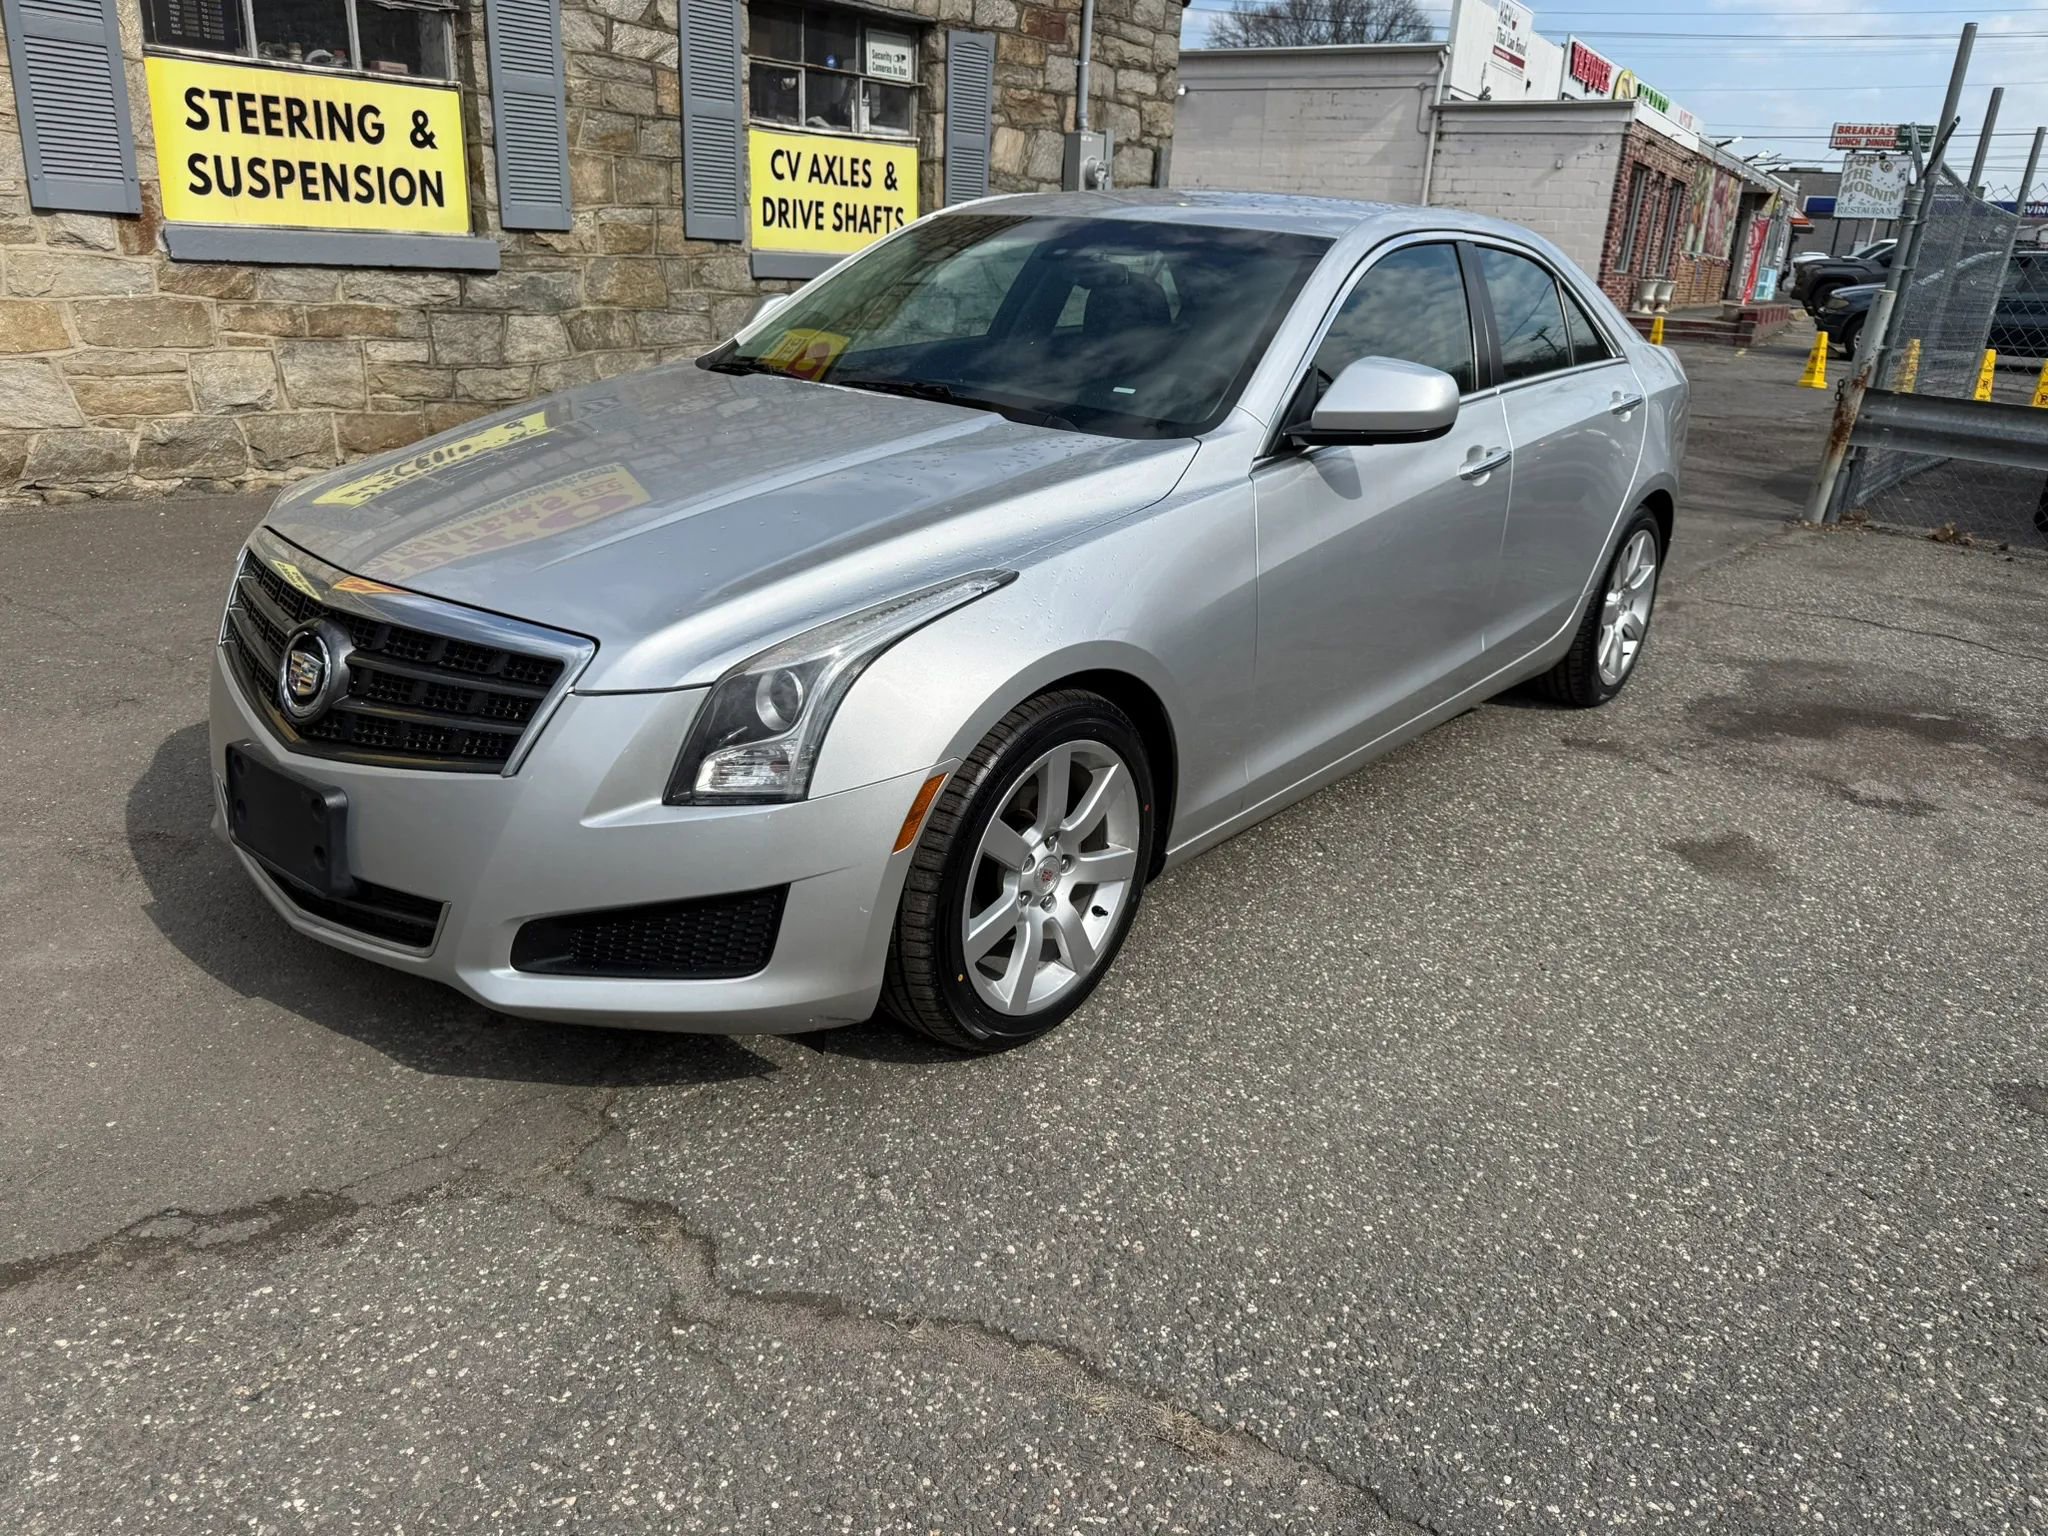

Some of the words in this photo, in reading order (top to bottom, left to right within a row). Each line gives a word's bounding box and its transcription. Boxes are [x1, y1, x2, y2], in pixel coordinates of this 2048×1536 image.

[872, 49, 892, 64] Security
[872, 61, 892, 74] Cameras
[184, 87, 385, 145] STEERING
[410, 109, 438, 150] &
[1837, 125, 1900, 136] BREAKFAST
[1834, 137, 1861, 146] LUNCH
[1865, 138, 1897, 148] DINNER
[770, 149, 801, 182] CV
[808, 153, 872, 188] AXLES
[884, 161, 898, 191] &
[1847, 155, 1877, 170] TOP
[187, 152, 445, 208] SUSPENSION
[1843, 168, 1873, 182] THE
[1840, 181, 1900, 202] MORNIN
[762, 196, 825, 231] DRIVE
[832, 201, 904, 234] SHAFTS
[1837, 206, 1899, 216] RESTAURANT
[2022, 205, 2048, 214] VIN
